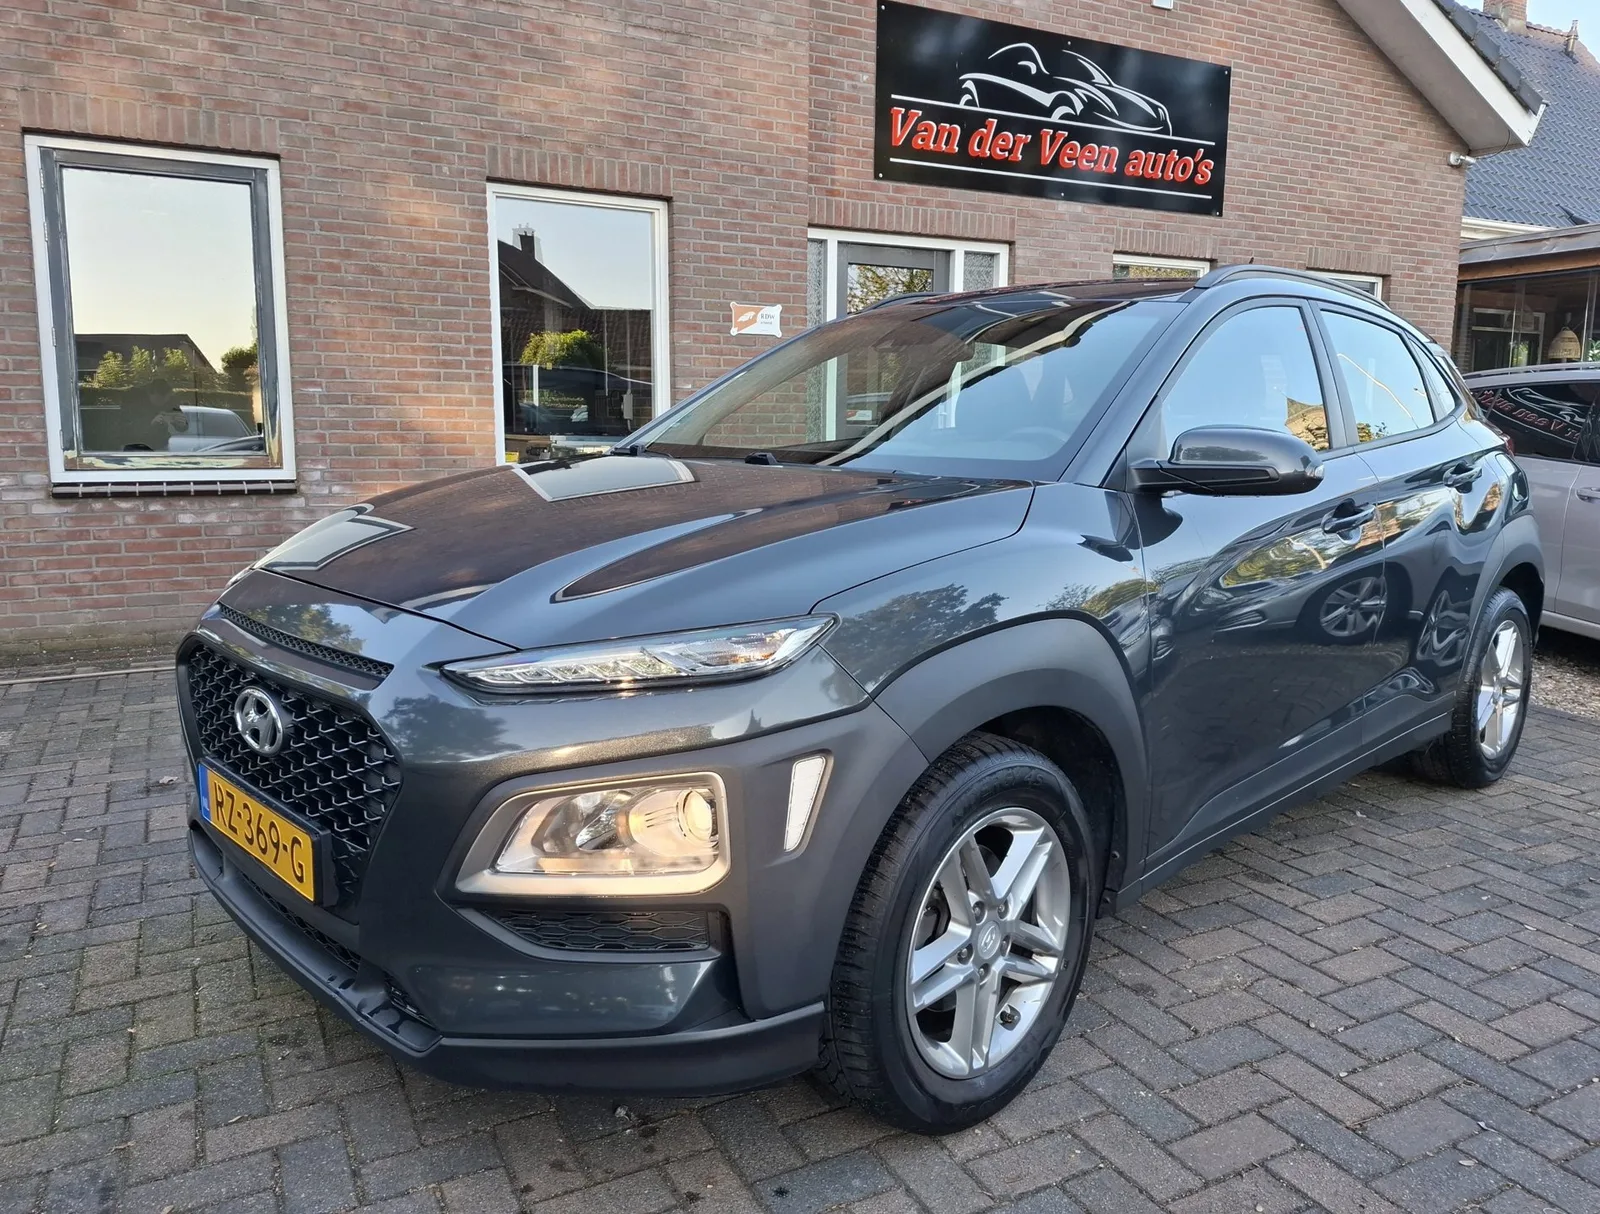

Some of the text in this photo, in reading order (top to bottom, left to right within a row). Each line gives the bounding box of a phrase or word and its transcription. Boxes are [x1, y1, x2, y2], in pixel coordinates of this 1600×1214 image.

[890, 107, 1214, 185] Van der Veen auto's
[213, 780, 305, 884] RZ-369-G
